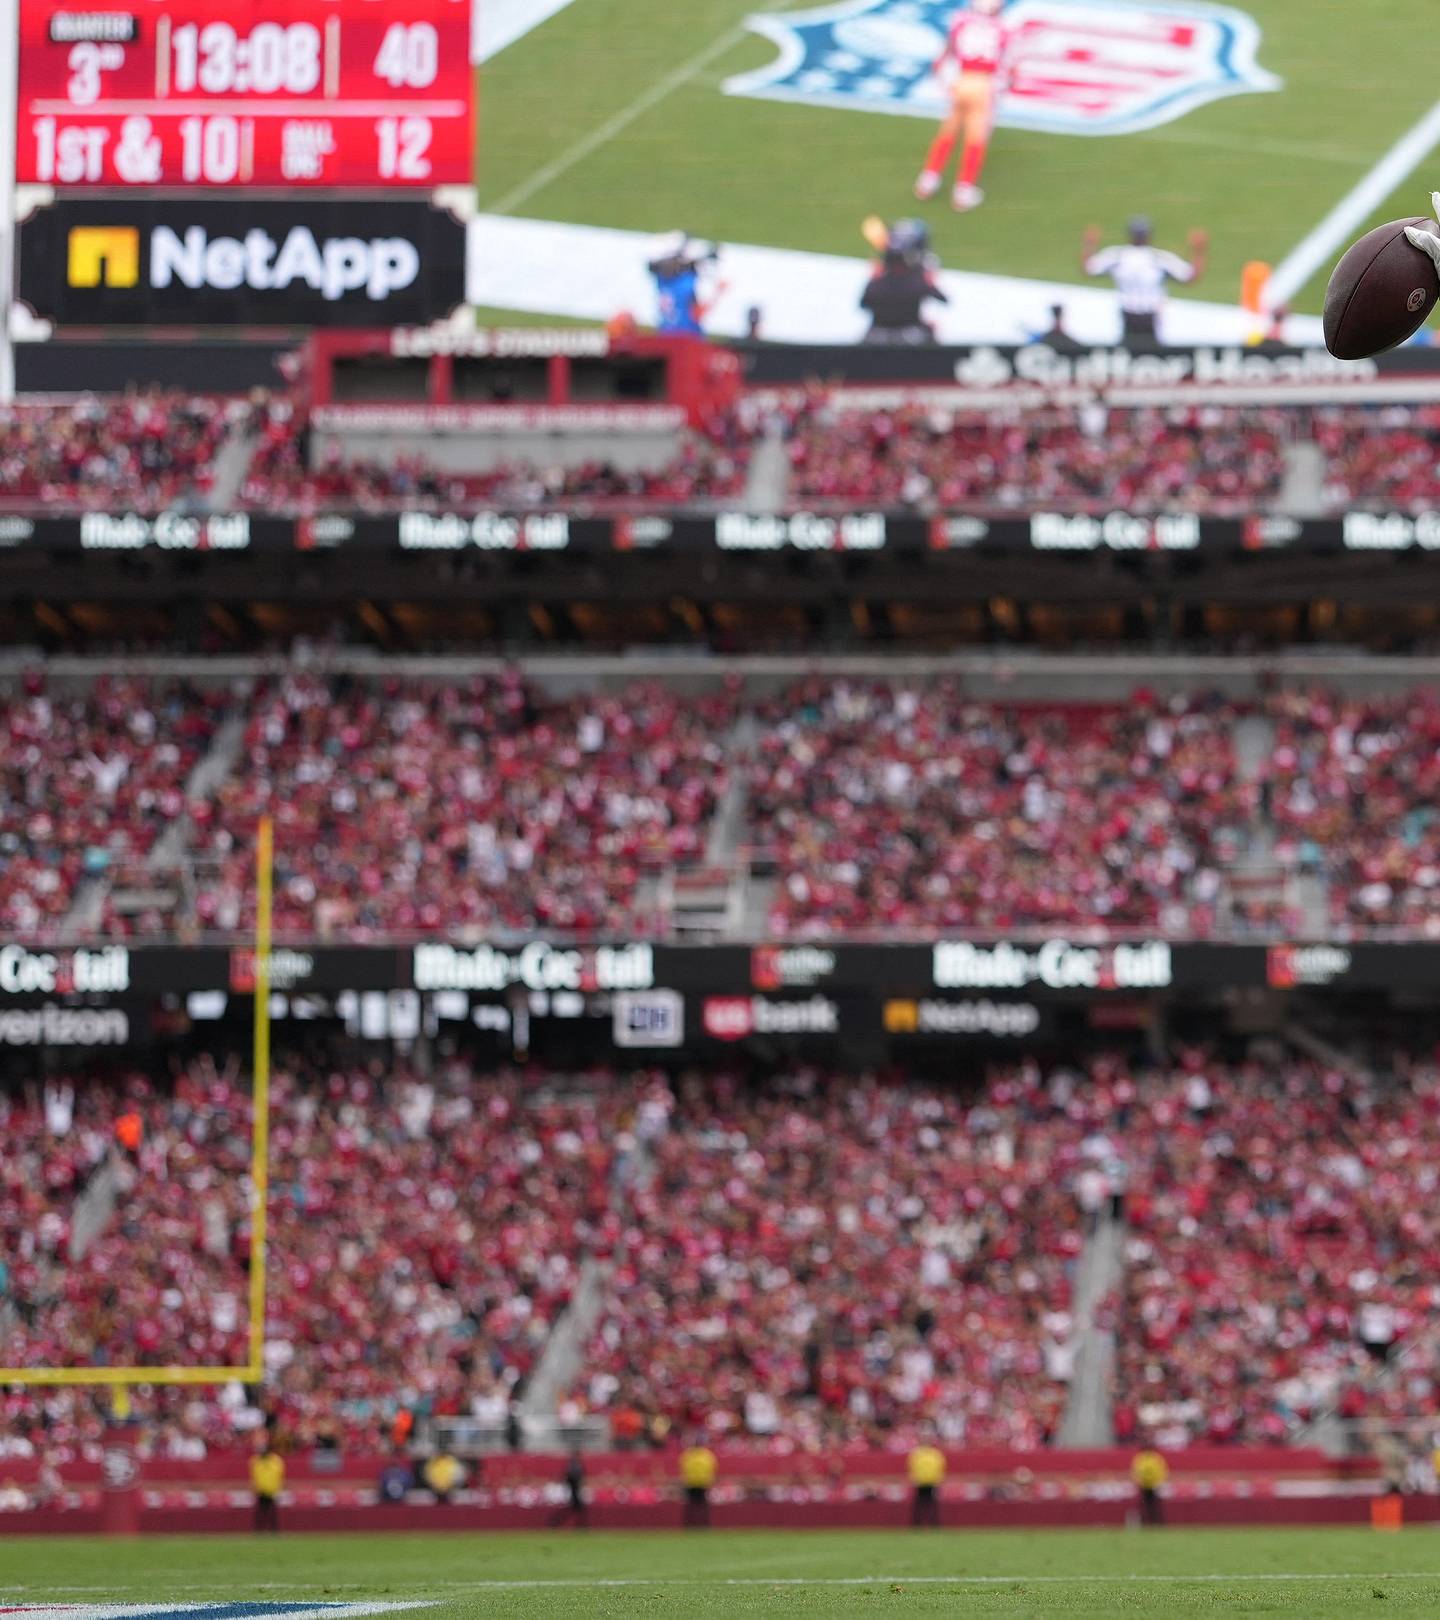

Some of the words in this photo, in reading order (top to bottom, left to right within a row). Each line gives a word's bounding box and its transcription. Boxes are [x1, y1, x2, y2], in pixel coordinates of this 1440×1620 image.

[172, 23, 321, 93] 13:08
[375, 23, 438, 90] 40
[114, 115, 163, 182] &
[180, 116, 238, 182] 10
[376, 116, 432, 178] 12
[150, 227, 419, 299] NetApp
